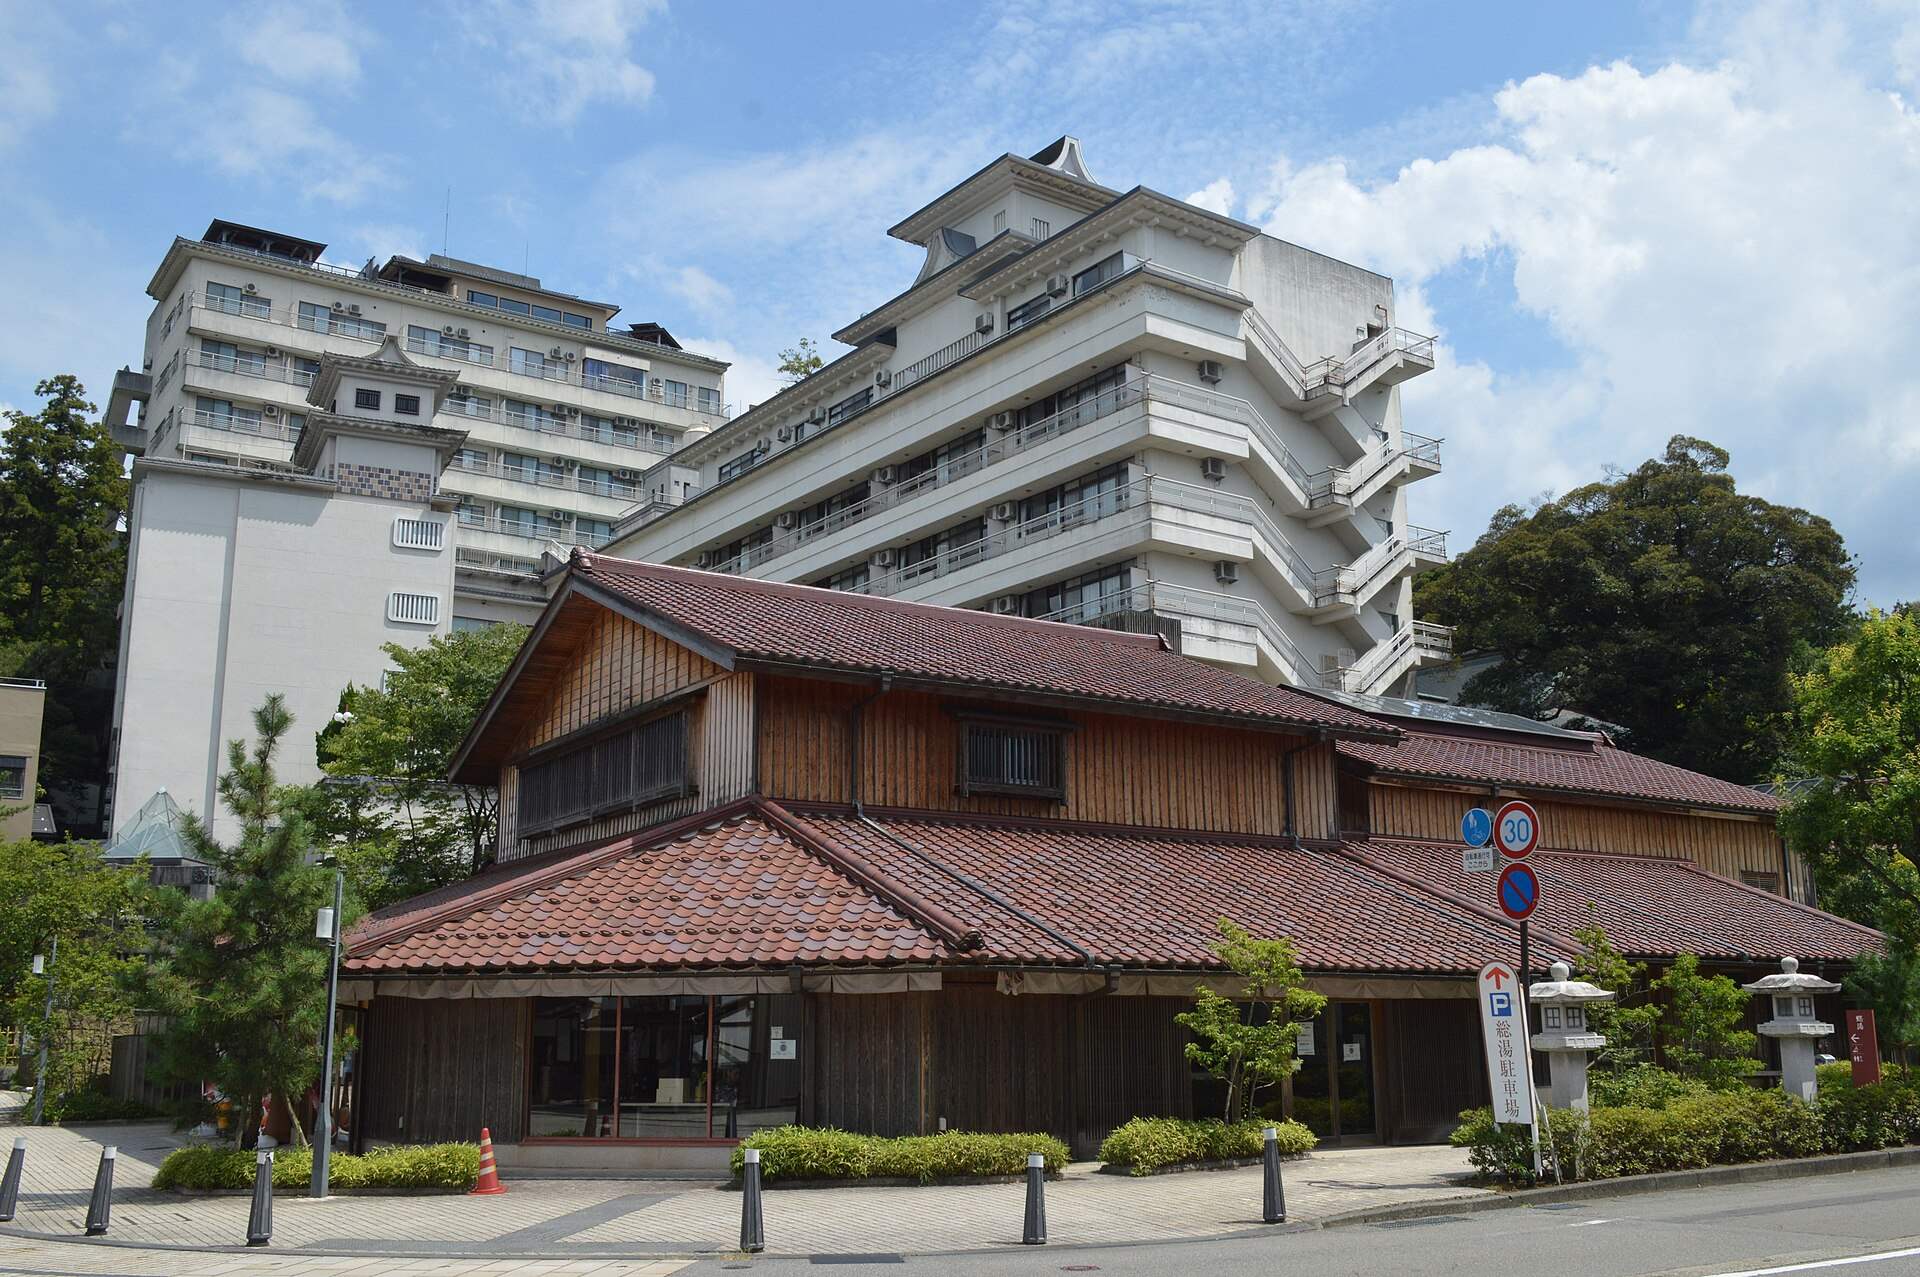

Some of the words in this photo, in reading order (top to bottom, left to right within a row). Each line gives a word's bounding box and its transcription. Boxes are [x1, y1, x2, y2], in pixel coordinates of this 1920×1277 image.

[1505, 819, 1529, 843] 30
[1467, 860, 1488, 868] ここから
[1491, 994, 1509, 1015] P
[1496, 1020, 1519, 1118] 総湯駐車場
